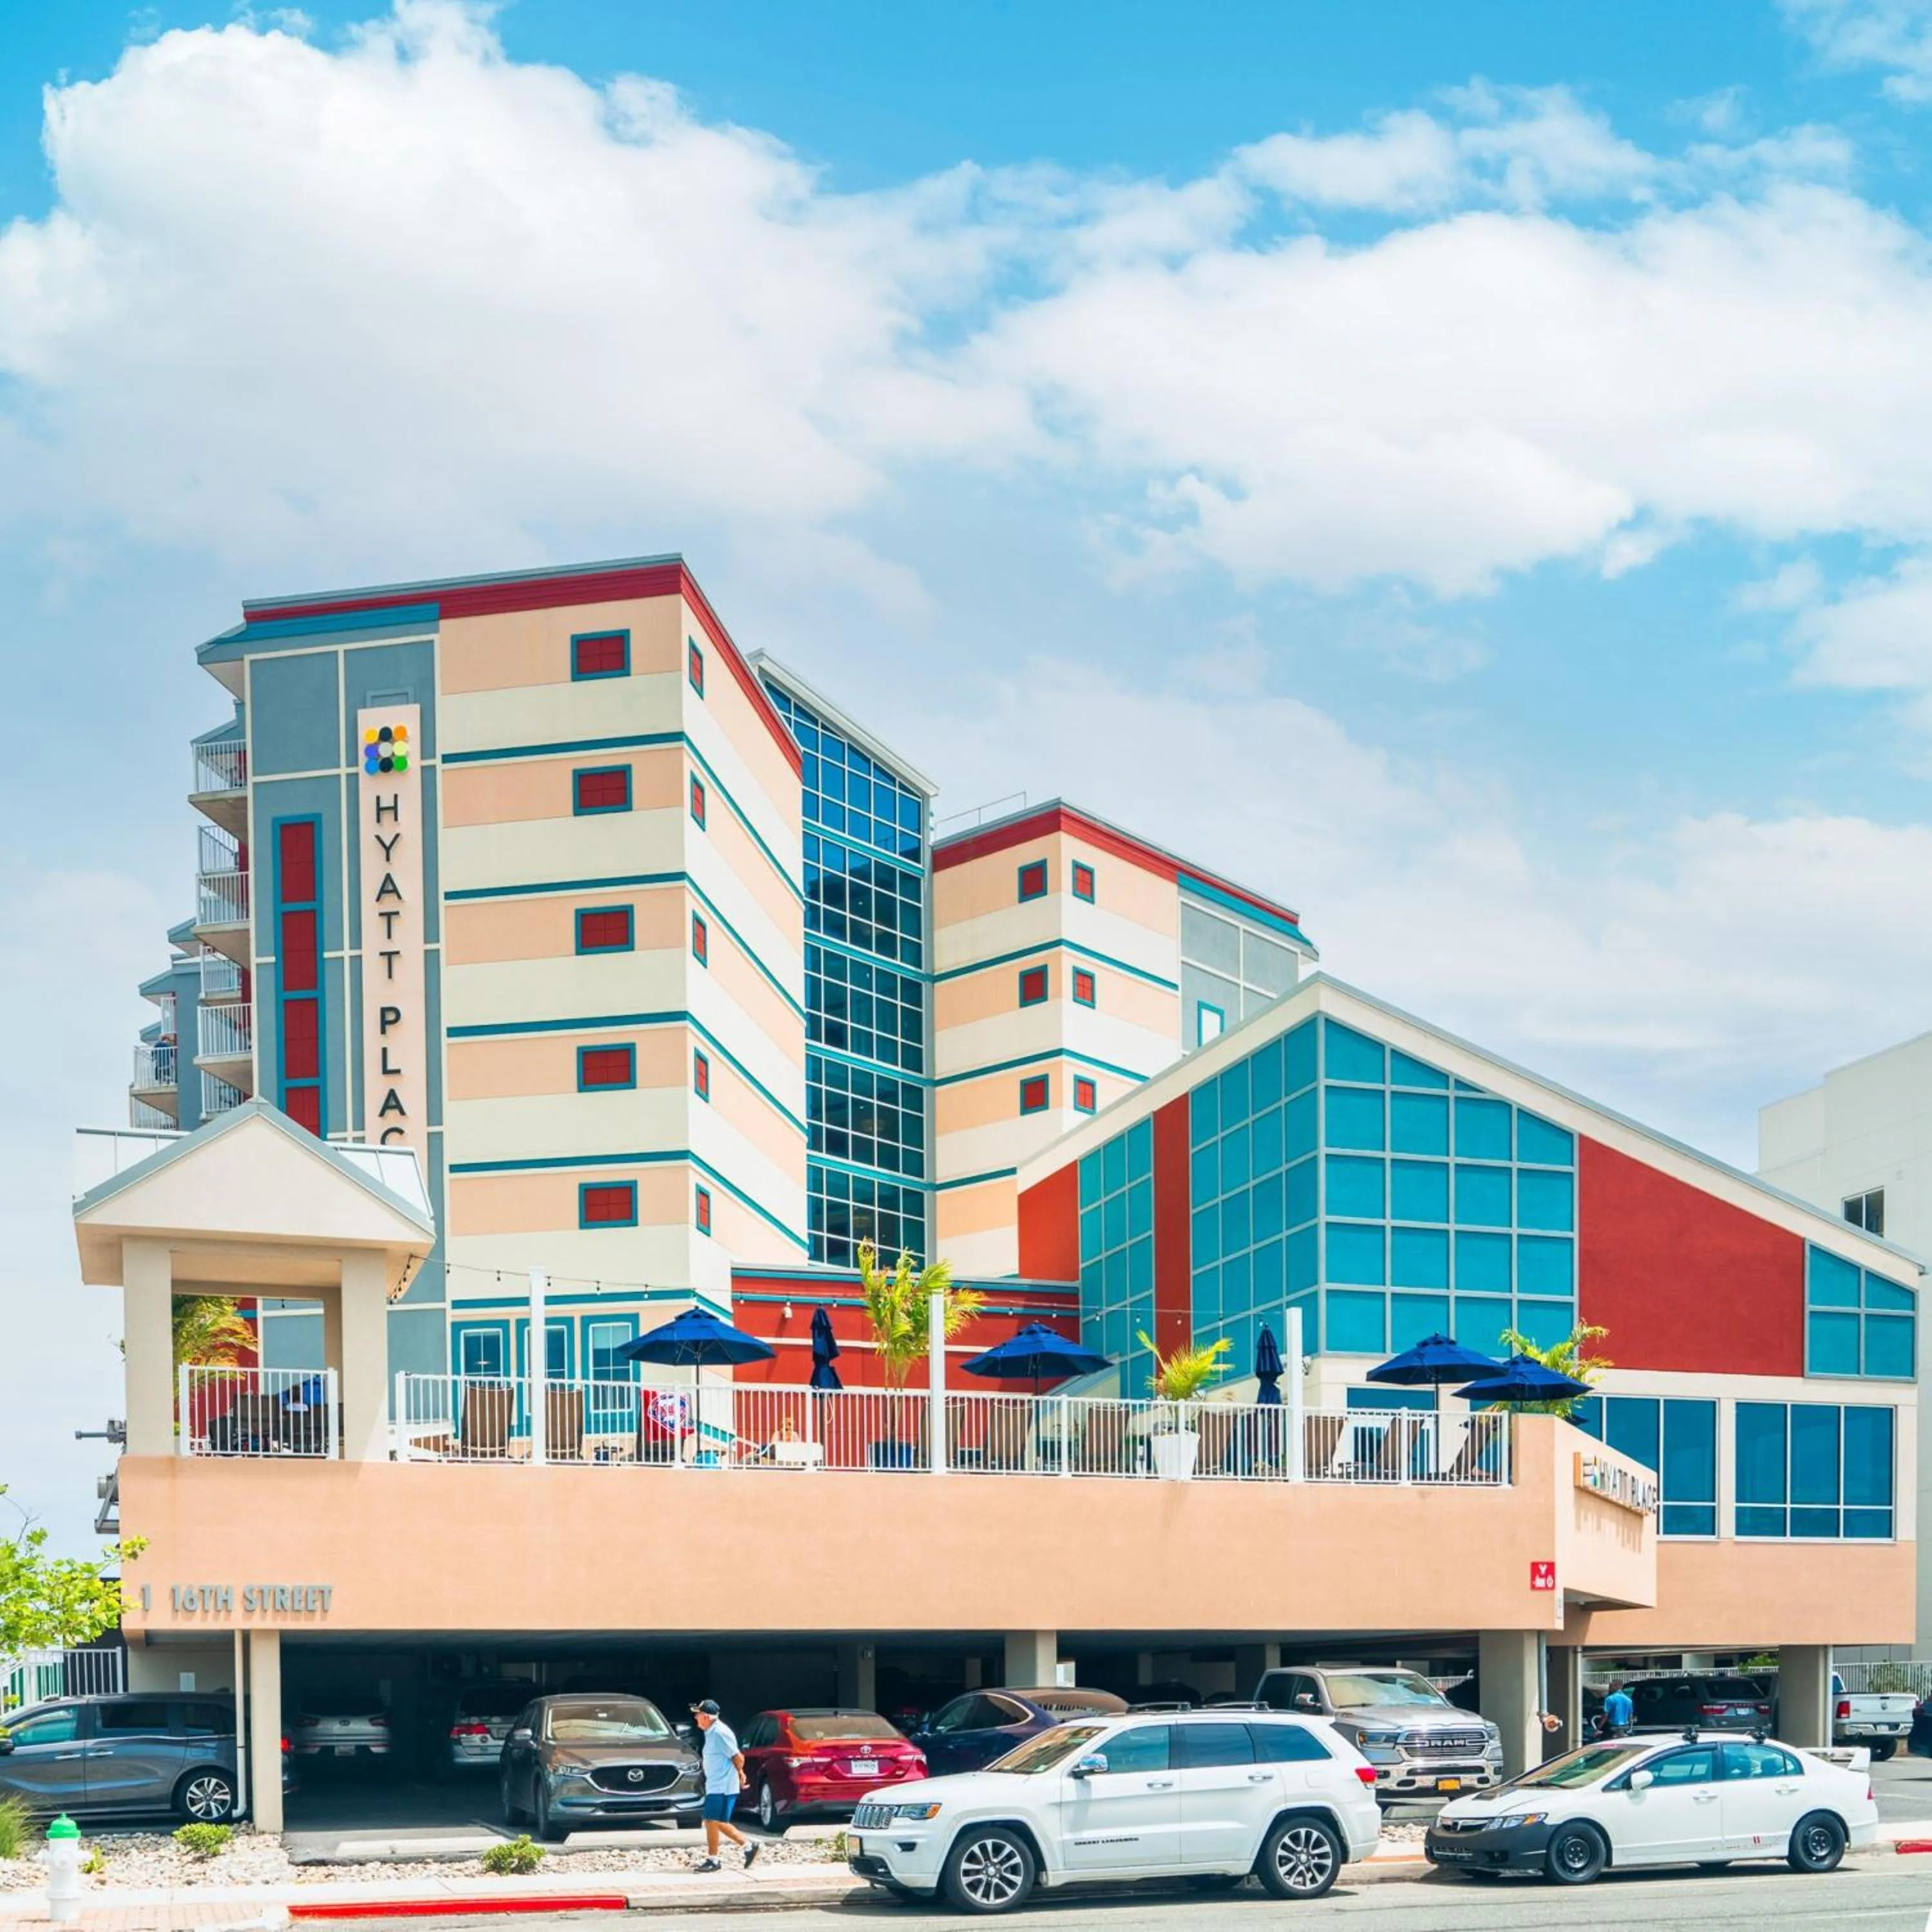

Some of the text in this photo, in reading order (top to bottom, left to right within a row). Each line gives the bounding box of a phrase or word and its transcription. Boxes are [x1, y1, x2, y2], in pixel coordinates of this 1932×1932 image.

[375, 793, 406, 1145] HYATT PLAC
[1599, 1459, 1628, 1501] HYATT
[141, 1584, 333, 1612] 1 16TH STREET
